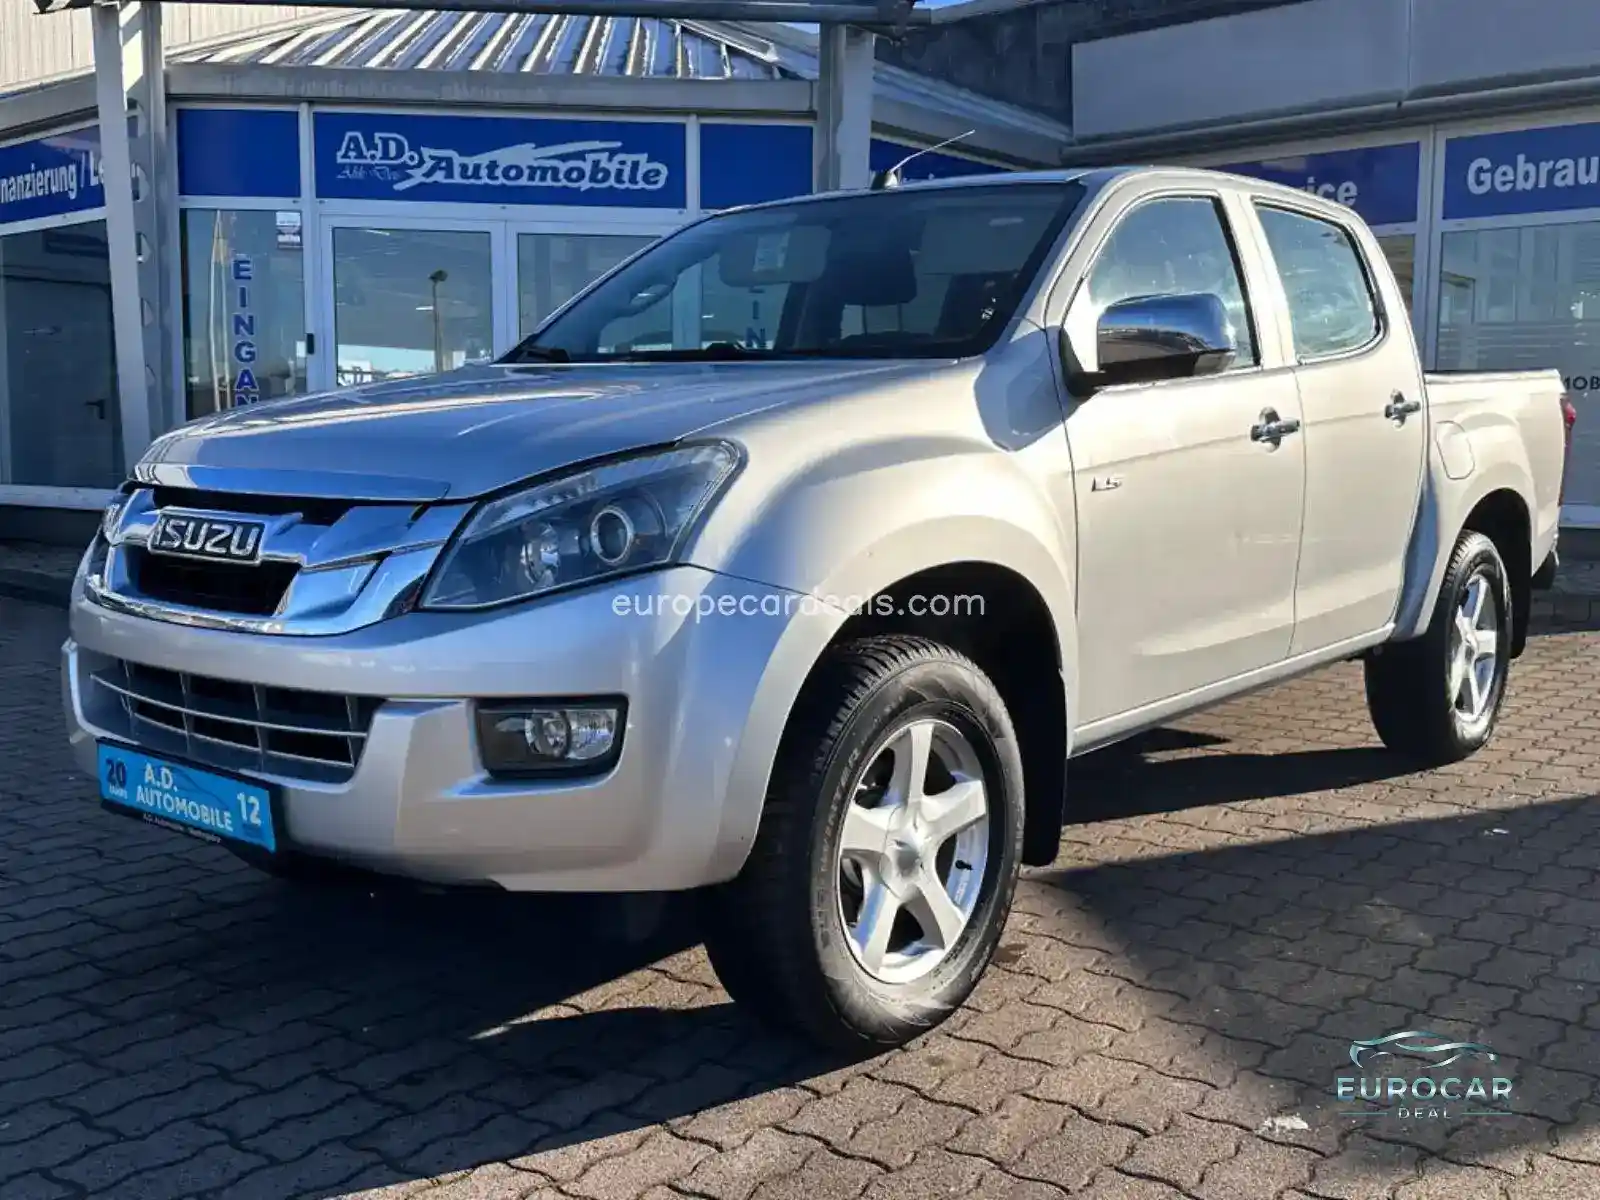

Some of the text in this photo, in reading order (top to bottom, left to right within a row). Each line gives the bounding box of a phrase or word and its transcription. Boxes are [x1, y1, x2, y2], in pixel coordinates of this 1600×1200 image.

[336, 131, 420, 166] A.D.
[416, 150, 667, 191] Automobile
[1467, 153, 1599, 194] Gebrau
[0, 163, 77, 200] nanzierung
[155, 517, 260, 556] ISUZU
[105, 758, 127, 788] 20
[144, 761, 179, 793] A.D.
[136, 785, 233, 832] AUTOMOBILE
[236, 791, 262, 827] 12
